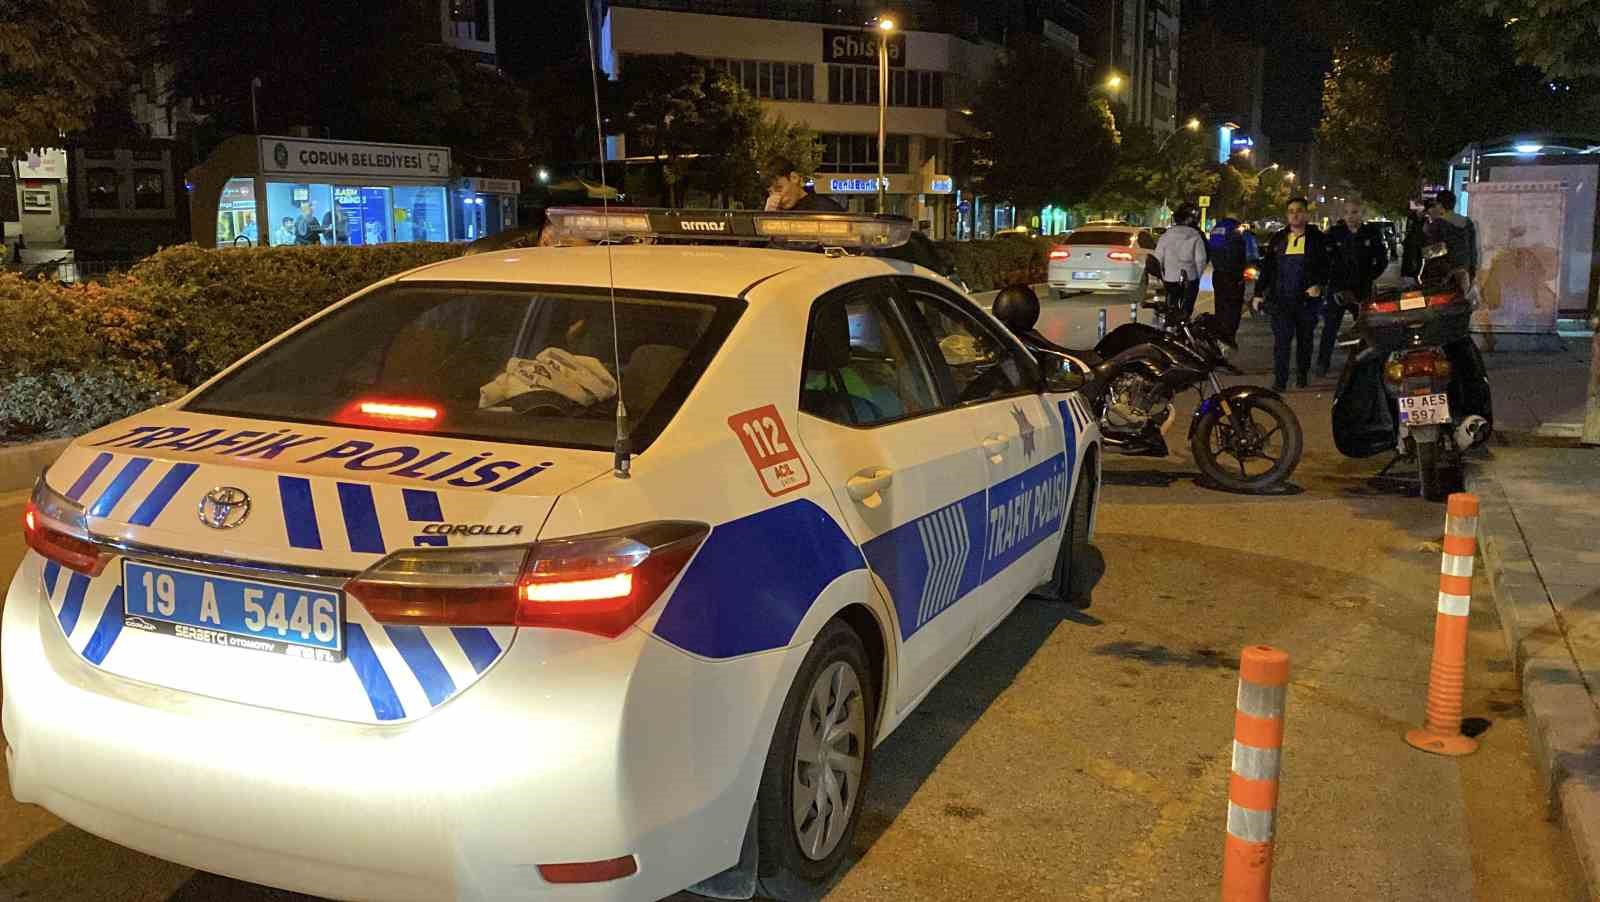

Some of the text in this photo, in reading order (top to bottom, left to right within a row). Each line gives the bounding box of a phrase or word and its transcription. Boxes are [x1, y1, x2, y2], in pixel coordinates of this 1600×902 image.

[299, 149, 423, 169] ÇORUM BELEDİYESİ
[680, 220, 727, 232] armas
[1400, 393, 1447, 408] 19 AES
[1411, 409, 1437, 421] 597
[742, 416, 788, 458] 112
[92, 425, 553, 493] TRAFİK POLİSİ
[987, 462, 1066, 561] TRAFİK POLİSİ
[422, 523, 524, 536] COROLLA
[142, 571, 335, 643] 19 A 5446
